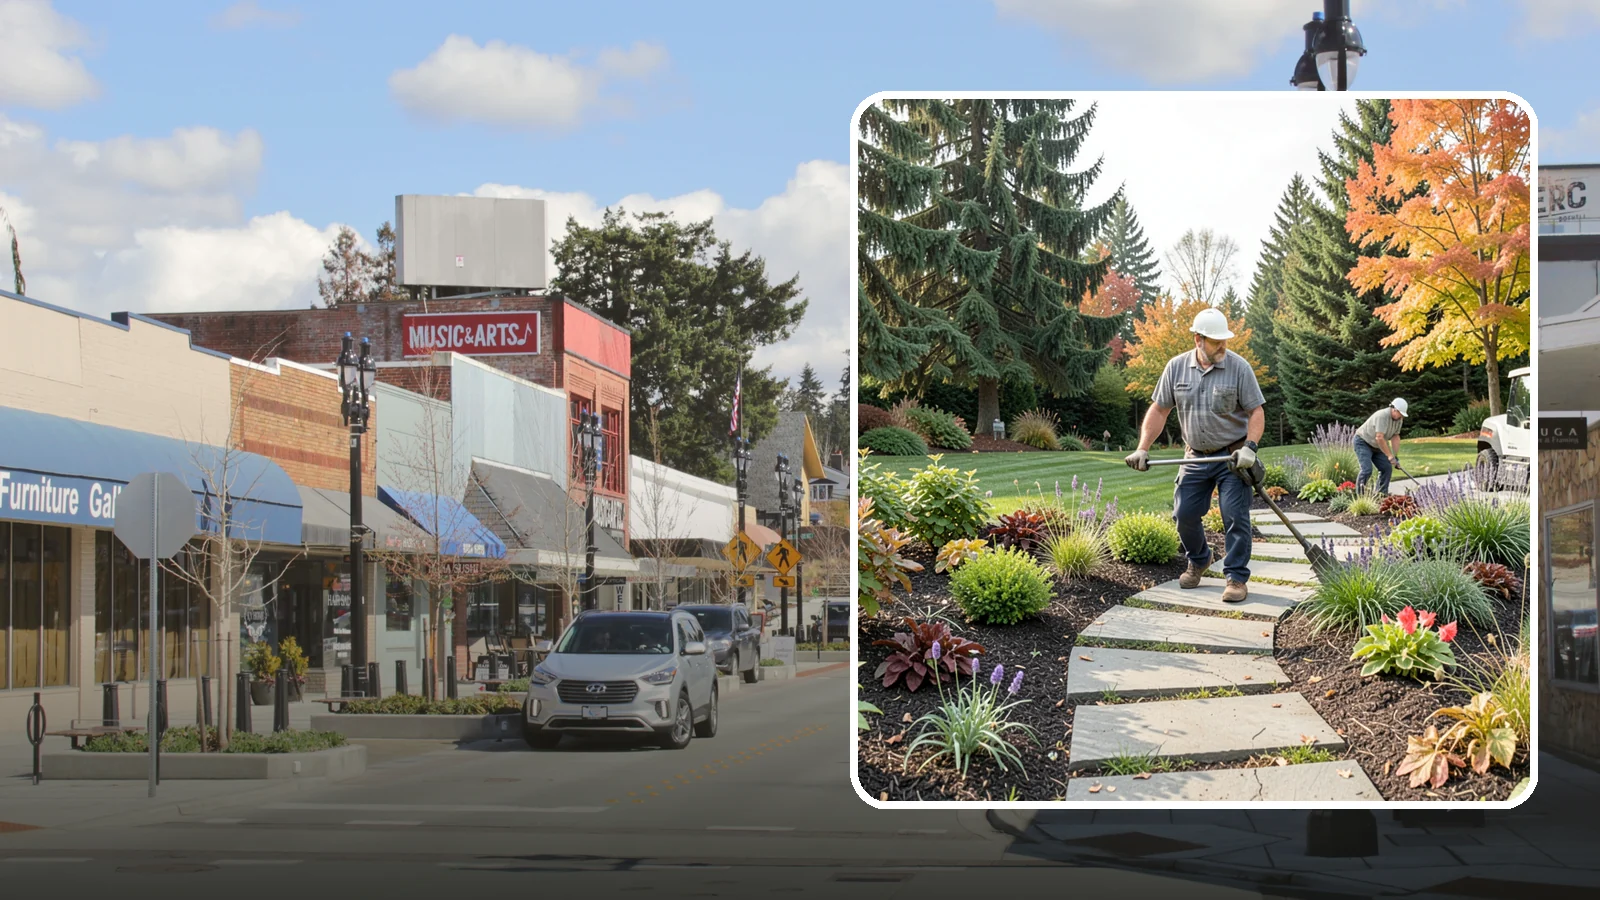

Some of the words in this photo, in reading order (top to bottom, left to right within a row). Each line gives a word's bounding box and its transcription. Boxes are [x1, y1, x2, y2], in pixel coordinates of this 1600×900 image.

[0, 471, 79, 516] Furniture
[89, 482, 121, 519] Gal
[453, 562, 479, 574] SUSHI
